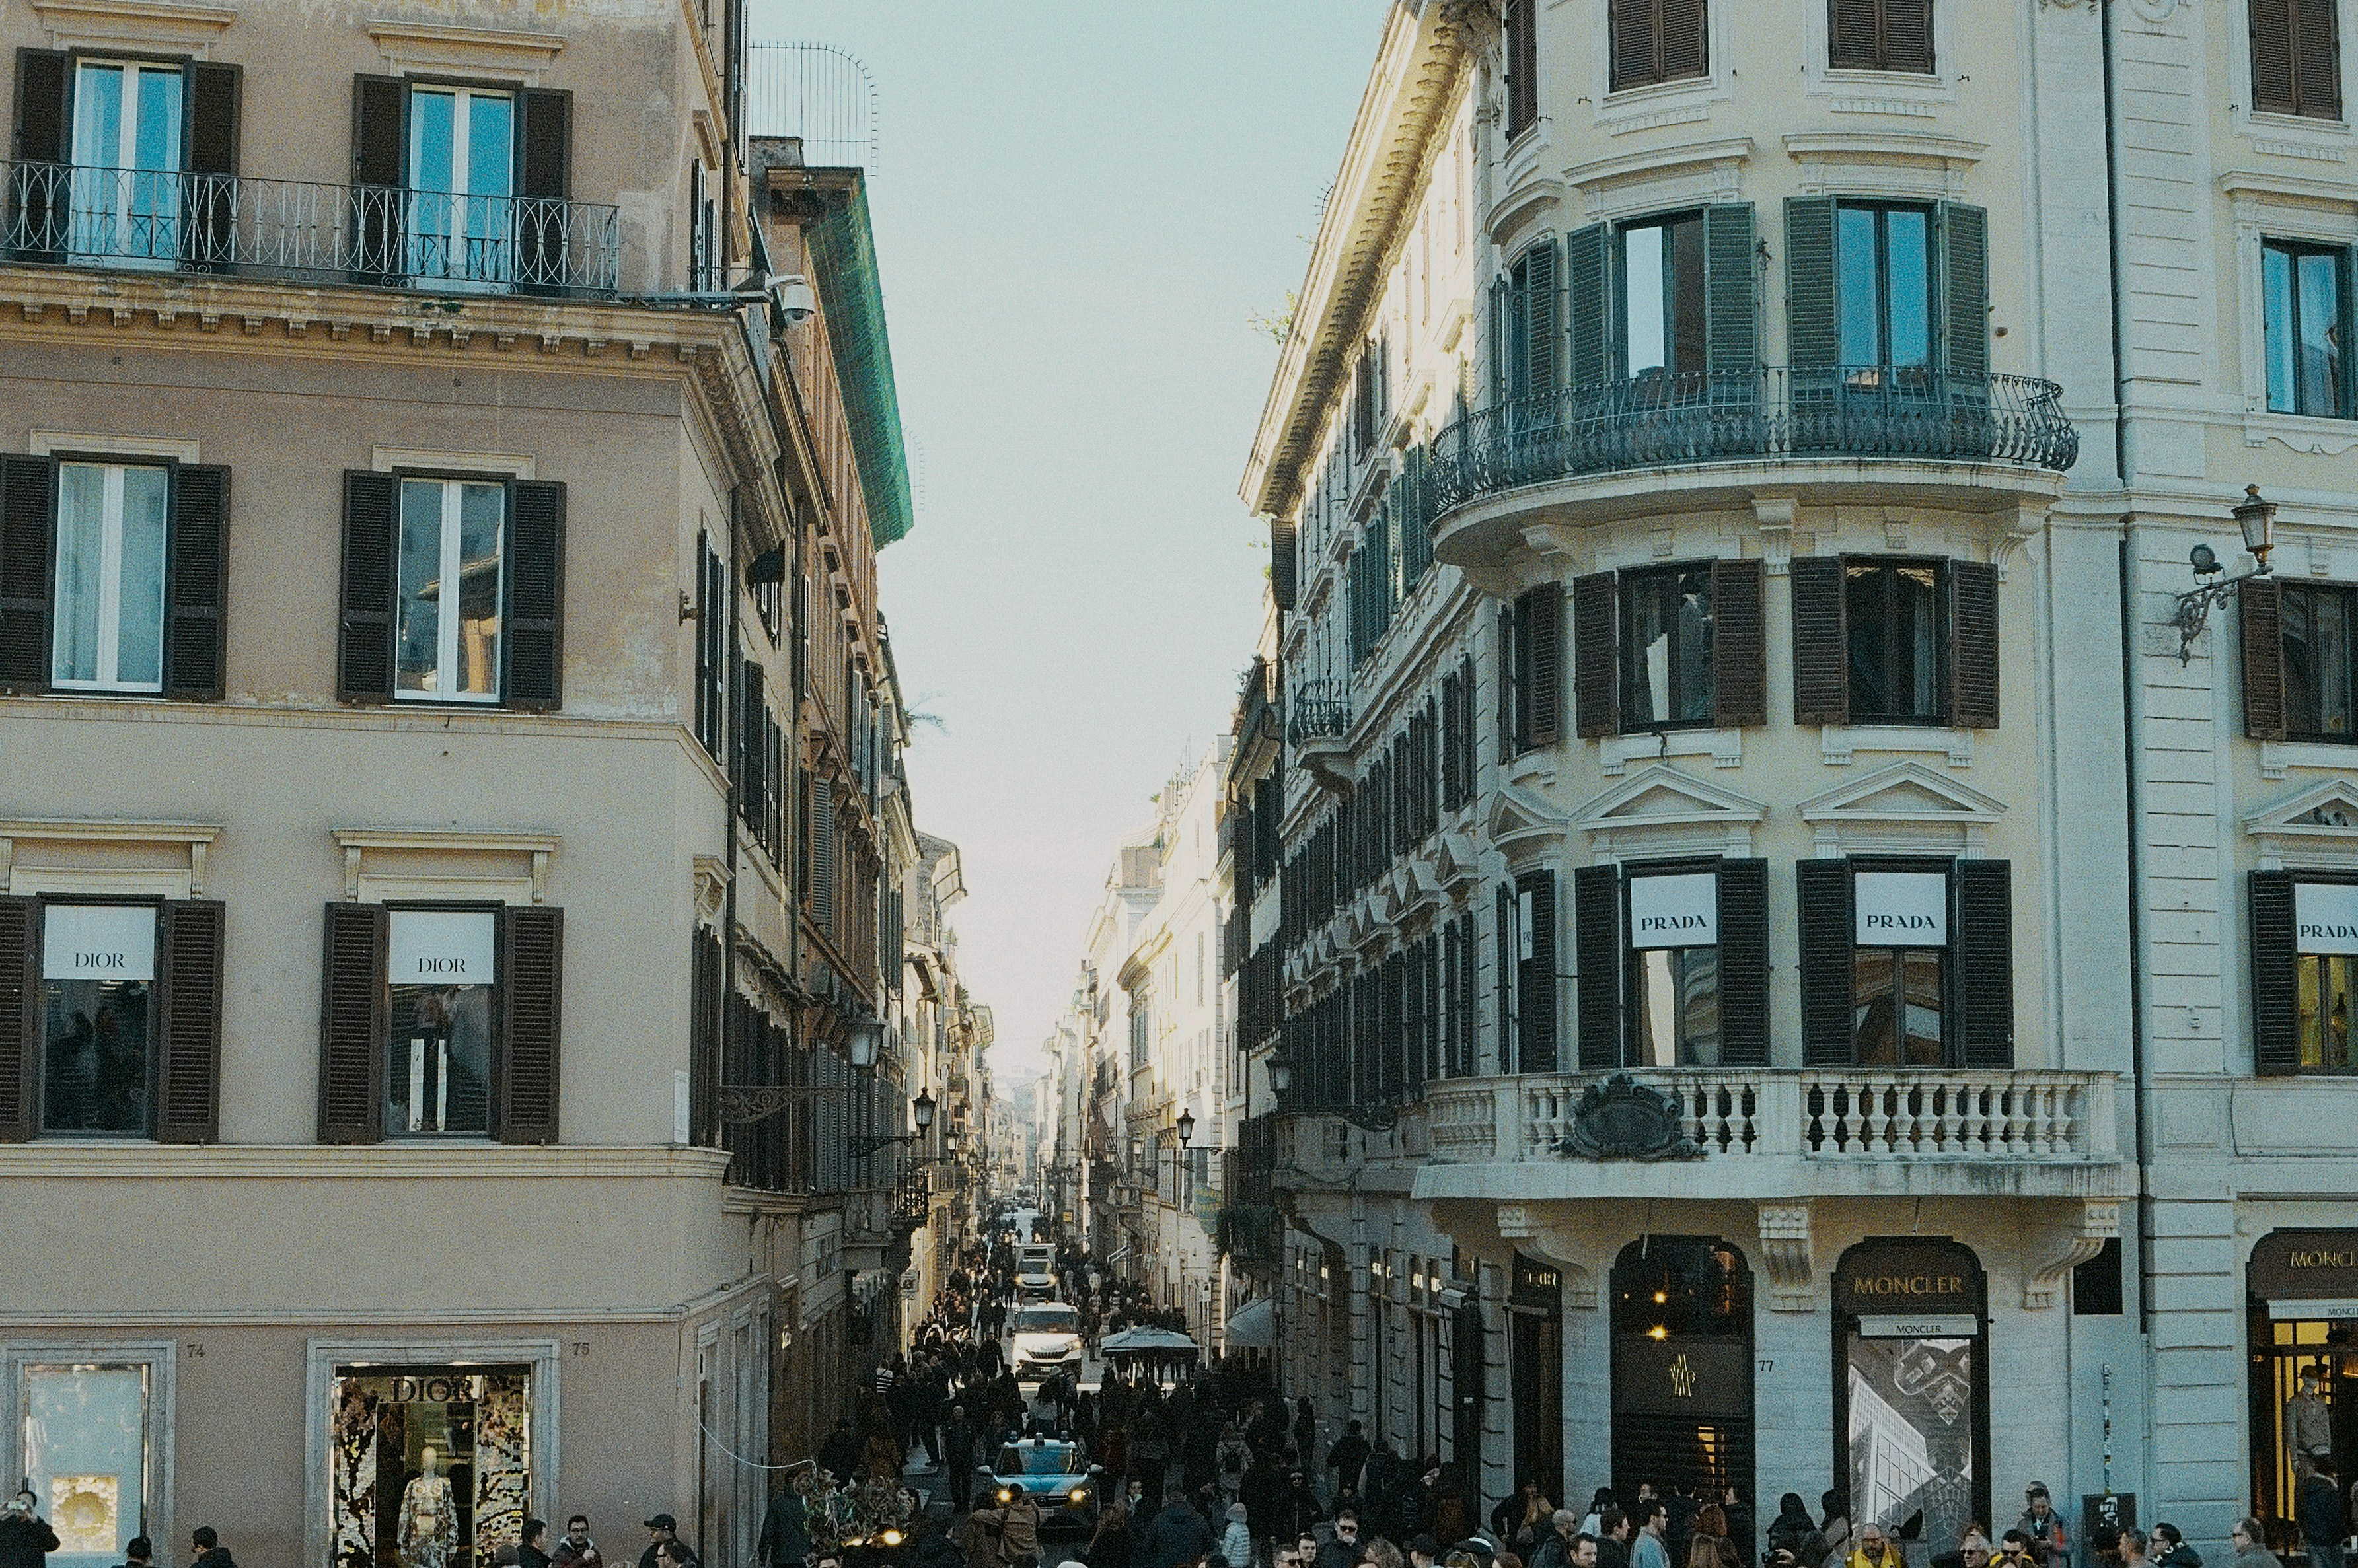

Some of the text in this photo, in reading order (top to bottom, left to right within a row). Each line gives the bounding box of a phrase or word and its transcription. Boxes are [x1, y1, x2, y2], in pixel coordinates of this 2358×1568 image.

[1641, 914, 1707, 931] PRADA
[1866, 915, 1937, 929] PRADA
[2301, 925, 2358, 938] PRADA
[75, 952, 125, 968] DIOR
[418, 958, 466, 972] DIOR
[1854, 1276, 1964, 1295] MONCLER
[1896, 1325, 1942, 1334] MONCLER
[187, 1342, 205, 1357] 74
[1758, 1360, 1773, 1372] 77
[391, 1377, 479, 1402] DIOR
